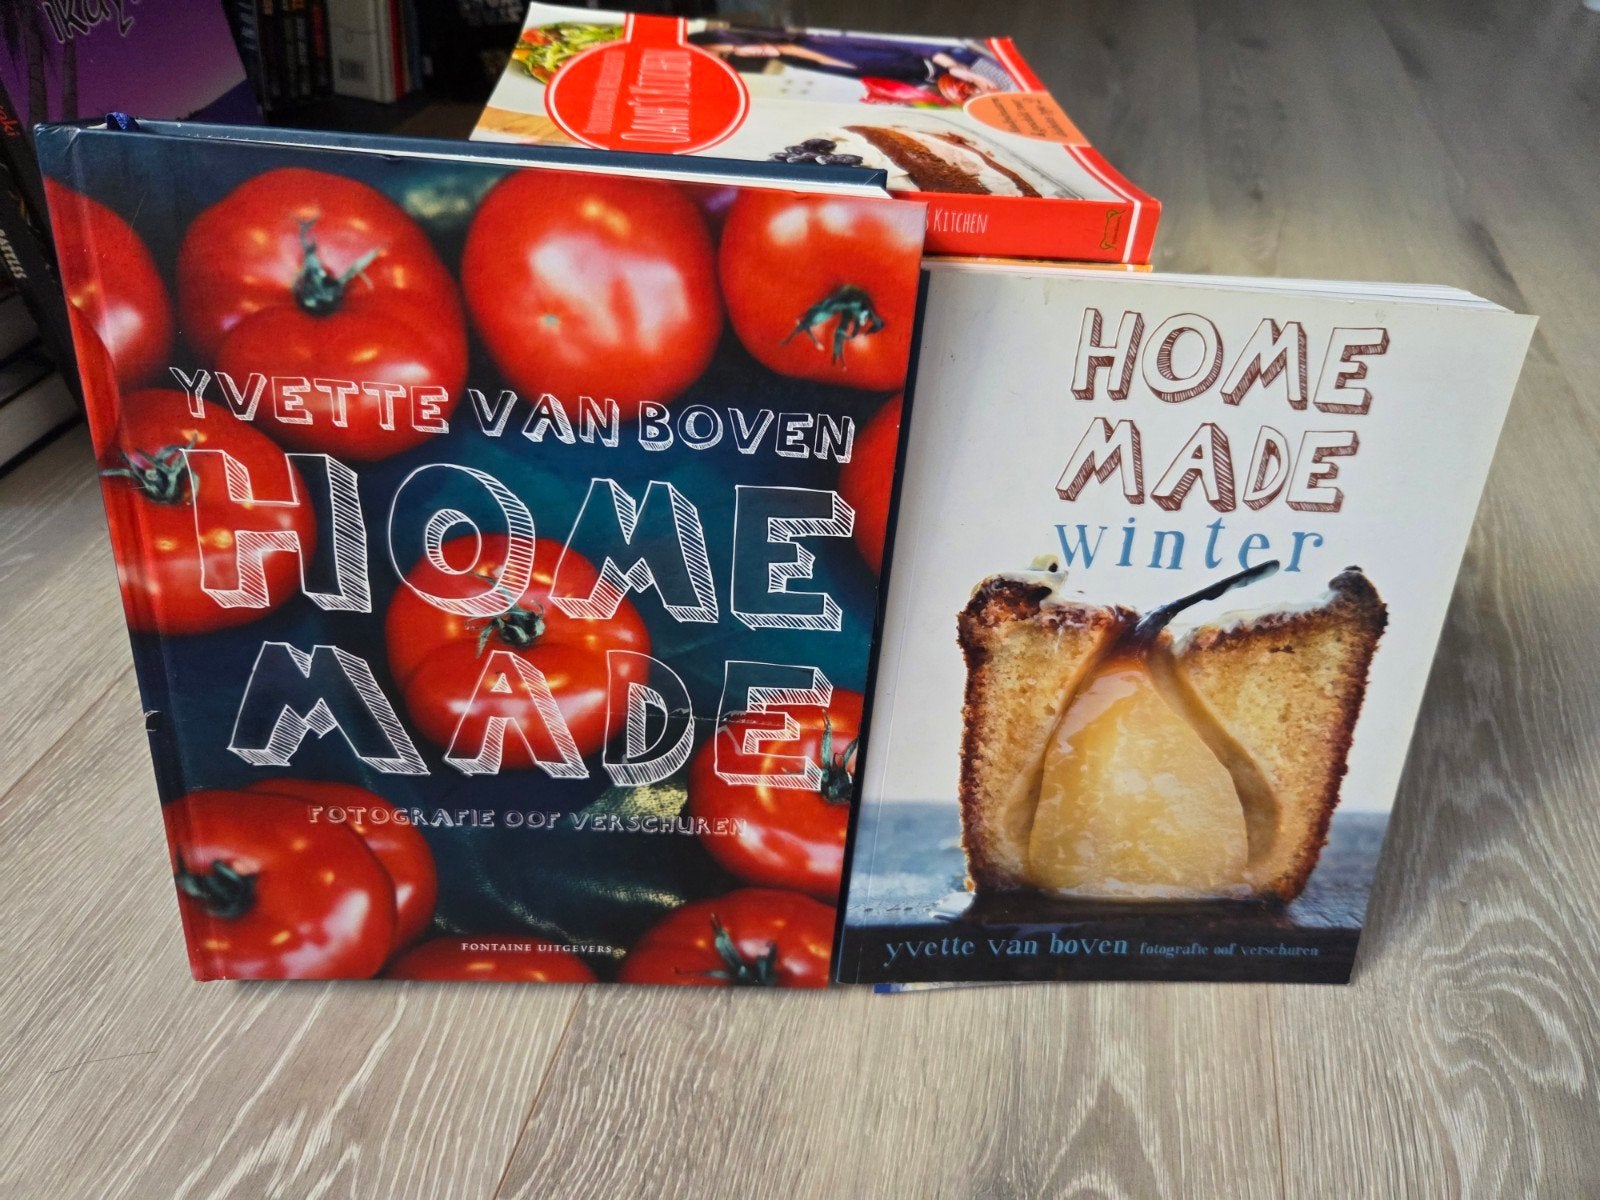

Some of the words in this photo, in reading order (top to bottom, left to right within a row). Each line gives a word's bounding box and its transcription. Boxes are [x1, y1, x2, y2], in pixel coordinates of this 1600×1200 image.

[933, 208, 988, 234] KITCHEN
[1070, 306, 1391, 416] HOME
[169, 366, 450, 434] YVETTE
[467, 388, 620, 447] VAN
[638, 400, 856, 464] BOVEN
[1054, 416, 1361, 514] MADE
[178, 448, 856, 632] HOME
[1053, 516, 1325, 574] winter
[226, 640, 834, 791] MADE
[308, 805, 496, 828] FOTOGRAFIE
[503, 809, 561, 829] OOF
[569, 811, 749, 836] VERSCHUREN
[461, 942, 532, 952] FONTAINE
[537, 944, 613, 954] UITGEVERS
[883, 936, 975, 968] yvette
[987, 937, 1038, 956] van
[1050, 932, 1128, 956] boven
[1139, 941, 1209, 960] fotografie
